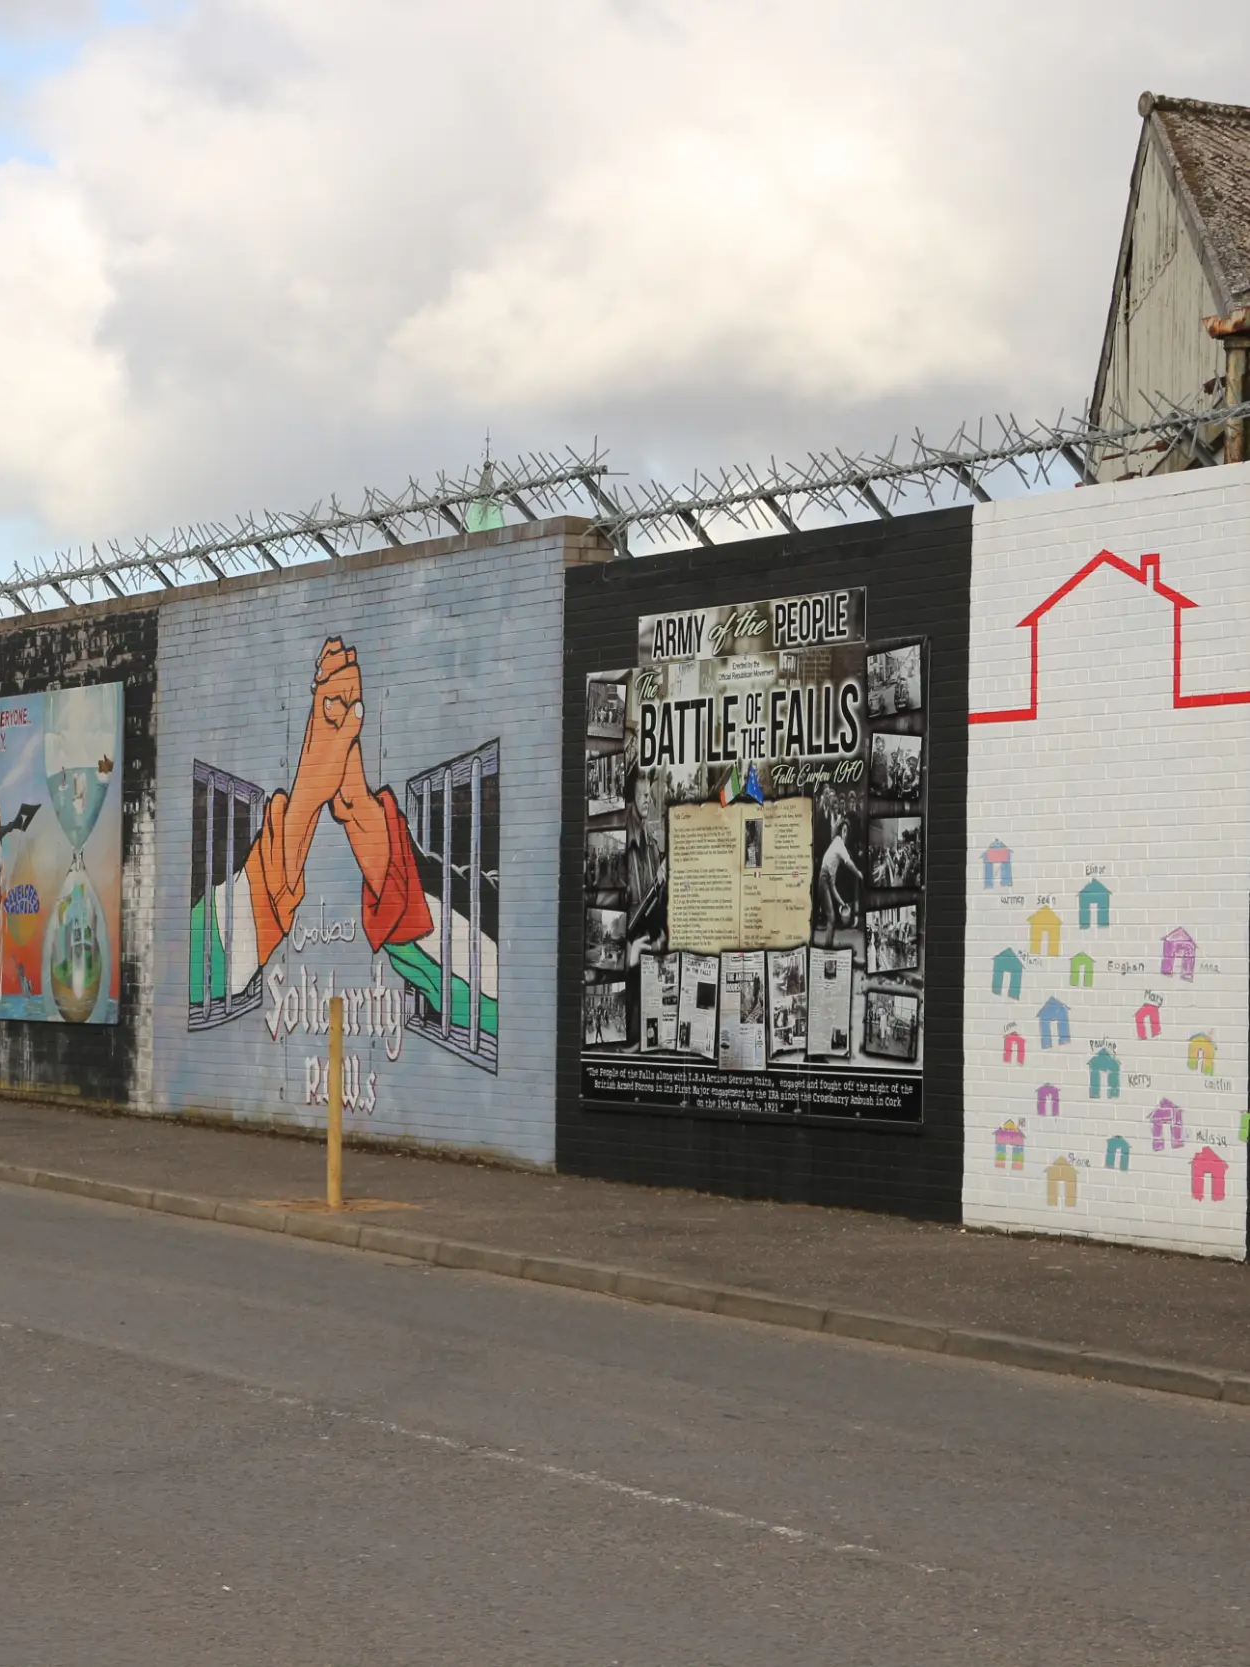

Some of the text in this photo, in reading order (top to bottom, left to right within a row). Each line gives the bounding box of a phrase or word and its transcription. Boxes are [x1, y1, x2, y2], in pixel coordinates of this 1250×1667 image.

[652, 594, 848, 659] ARMY of the PEOPLE
[635, 671, 659, 704] The
[746, 692, 763, 725] OF
[639, 683, 859, 767] BATTLE FALLS
[740, 727, 767, 760] THE
[771, 764, 796, 787] Falls
[1107, 960, 1145, 976] Eoghan
[1144, 989, 1164, 1006] Mary
[594, 1080, 616, 1089] British
[616, 1081, 634, 1090] Armed
[634, 1082, 654, 1092] Forces
[655, 1083, 663, 1092] in
[663, 1084, 673, 1093] its
[674, 1085, 691, 1094] First
[692, 1085, 710, 1096] Major
[711, 1088, 745, 1098] engagement
[746, 1088, 754, 1099] by
[755, 1089, 767, 1099] the
[768, 1090, 780, 1100] IRA
[780, 1091, 800, 1101] since
[800, 1092, 812, 1102] the
[850, 1095, 874, 1106] Ambush
[875, 1096, 884, 1106] in
[884, 1097, 902, 1107] Cork
[599, 1068, 619, 1080] People
[619, 1069, 627, 1078] of
[627, 1069, 638, 1079] the
[638, 1070, 655, 1080] Falls
[656, 1071, 673, 1083] along
[673, 1072, 687, 1082] with
[706, 1074, 727, 1084] Active
[728, 1075, 753, 1085] Service
[754, 1077, 775, 1087] Units,
[779, 1079, 806, 1090] engaged
[806, 1079, 818, 1089] and
[819, 1080, 842, 1092] fought
[843, 1082, 855, 1091] off
[856, 1082, 868, 1092] the
[869, 1083, 889, 1095] might
[891, 1084, 899, 1093] of
[900, 1084, 913, 1094] the
[705, 1098, 716, 1108] the
[717, 1099, 732, 1109] 19th
[732, 1100, 740, 1109] of
[740, 1101, 762, 1112] March,
[764, 1102, 779, 1112] 1921
